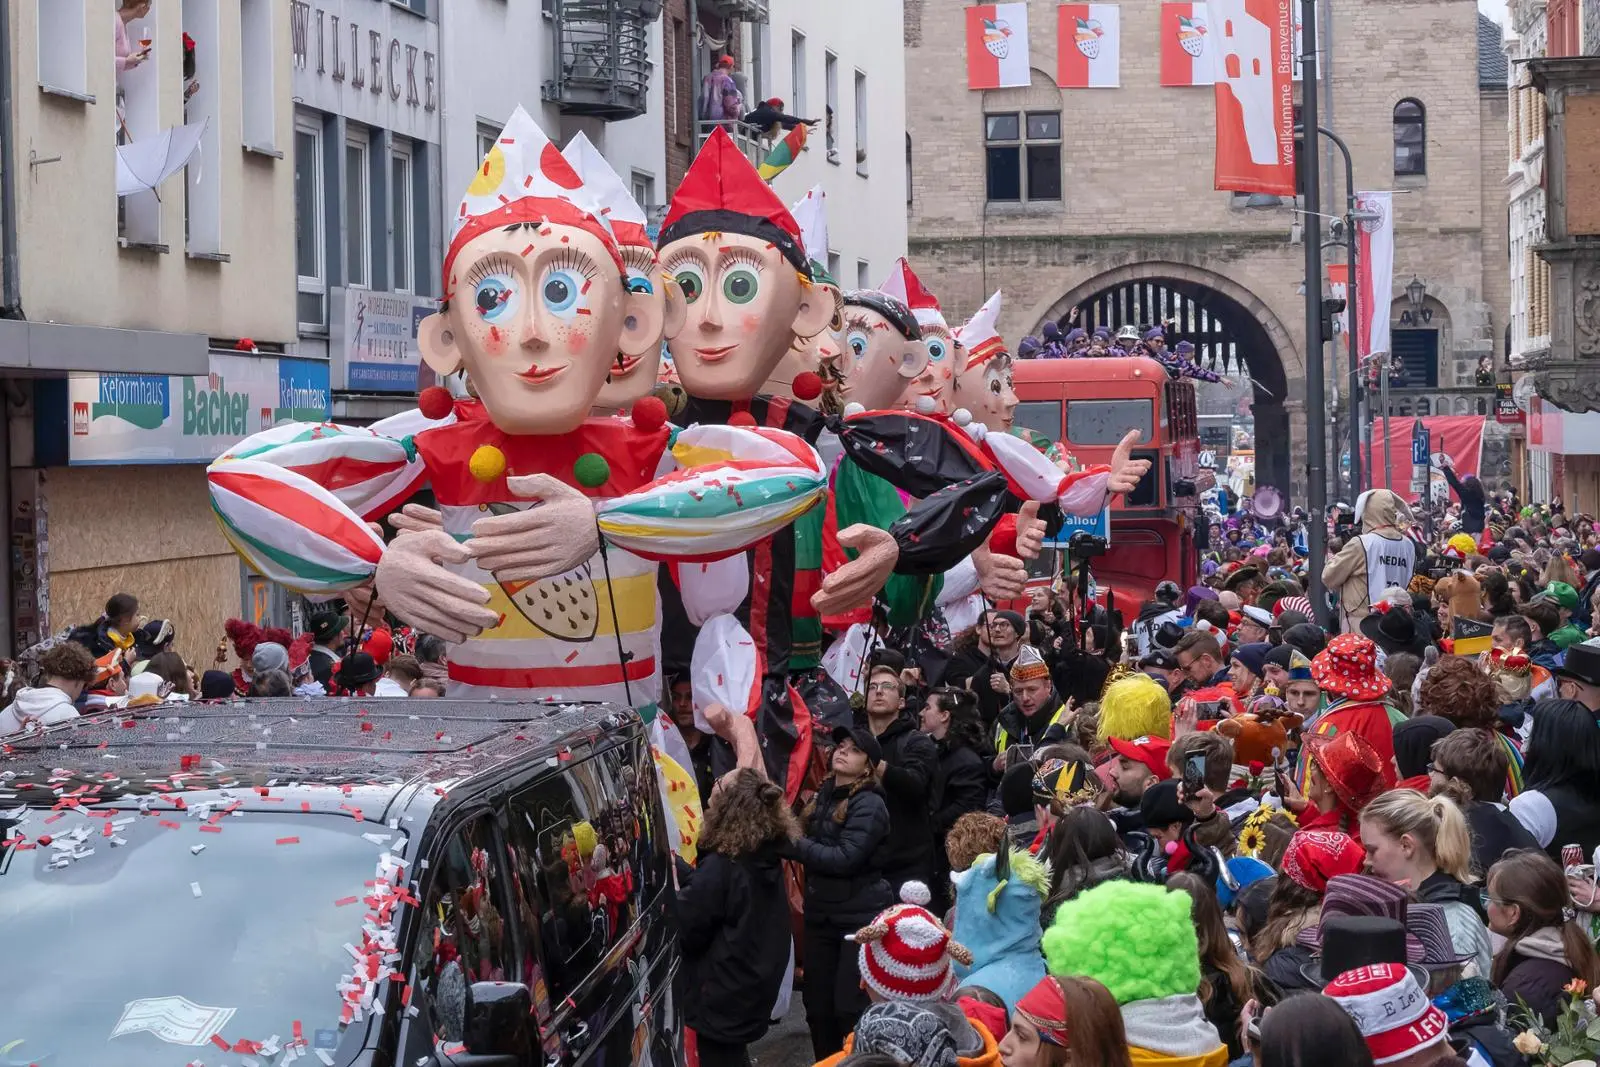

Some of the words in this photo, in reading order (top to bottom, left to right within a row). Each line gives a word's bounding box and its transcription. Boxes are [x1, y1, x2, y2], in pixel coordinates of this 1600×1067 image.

[290, 1, 436, 111] WILLECKE
[1278, 0, 1290, 74] Bienvenue
[1280, 84, 1293, 166] wellkumme
[367, 338, 408, 359] WILLECKE
[101, 375, 164, 406] Reformhaus
[183, 376, 249, 437] Bacher
[280, 377, 326, 410] Reformhaus
[1382, 1001, 1397, 1017] E
